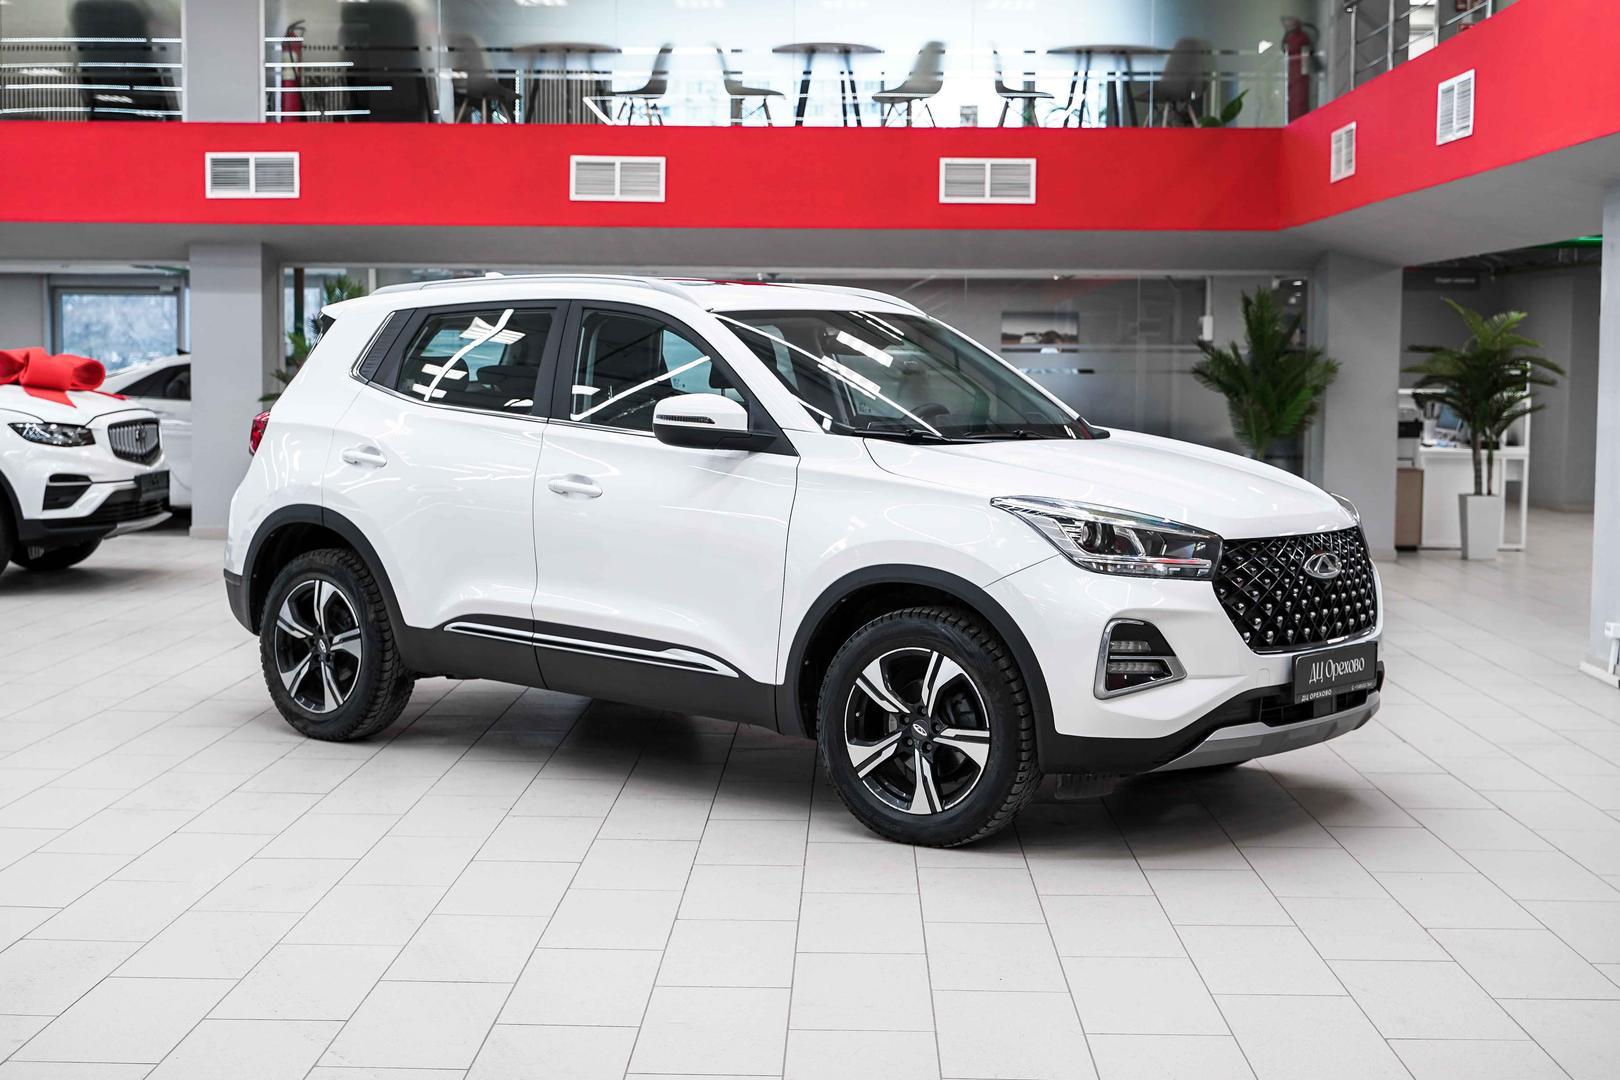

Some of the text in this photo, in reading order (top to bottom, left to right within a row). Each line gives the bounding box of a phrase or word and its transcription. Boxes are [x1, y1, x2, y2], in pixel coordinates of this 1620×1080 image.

[1309, 657, 1365, 684] ДЦ Орехово
[1309, 689, 1332, 700] ОРЕХОВО
